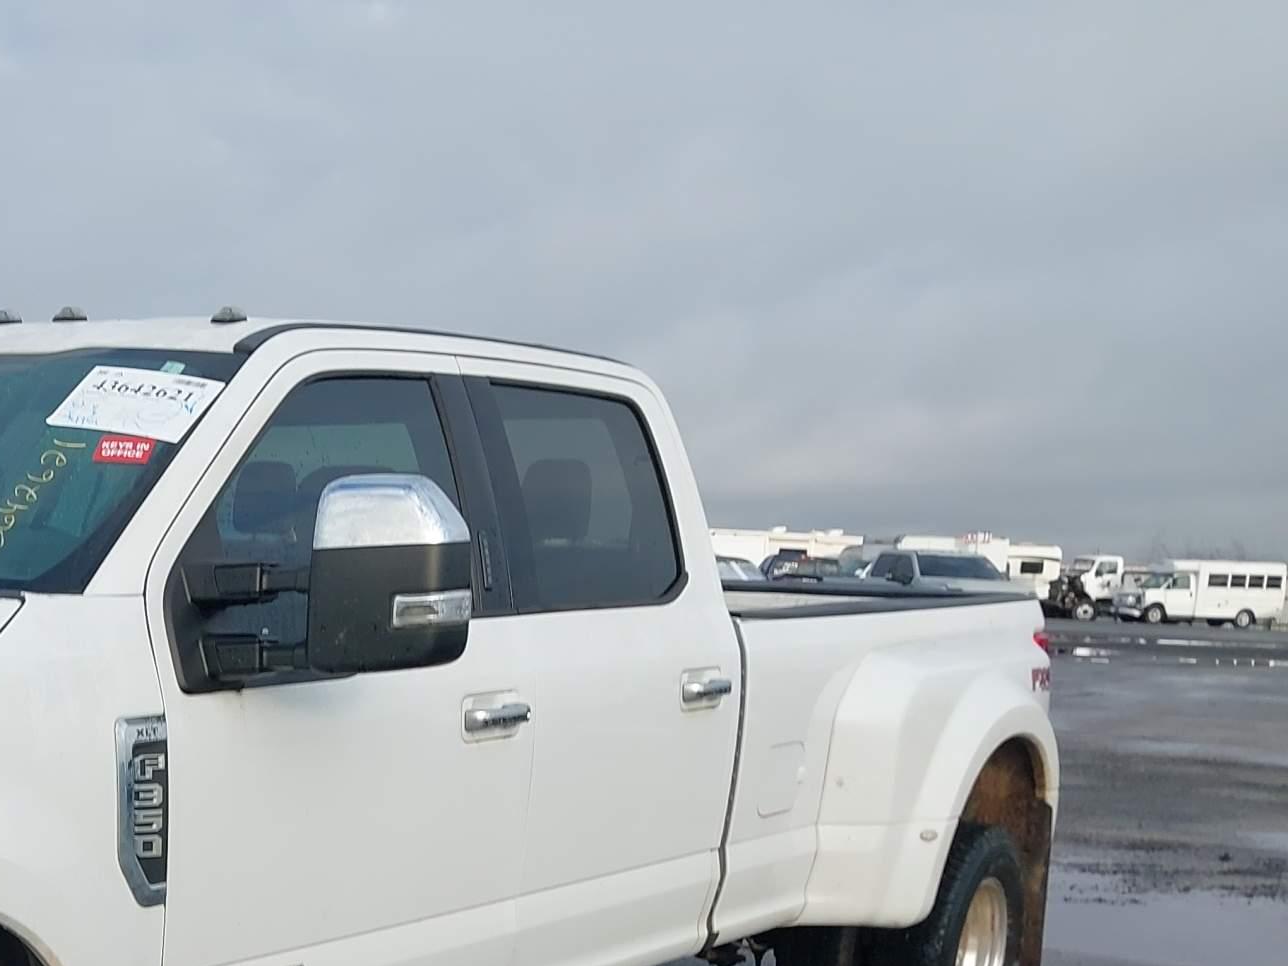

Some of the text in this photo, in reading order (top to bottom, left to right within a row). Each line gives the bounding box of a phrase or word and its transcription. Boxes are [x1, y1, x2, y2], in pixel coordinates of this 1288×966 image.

[136, 441, 150, 451] IN
[101, 449, 144, 459] OFFICE
[136, 726, 159, 739] XLT
[133, 752, 166, 858] F350
